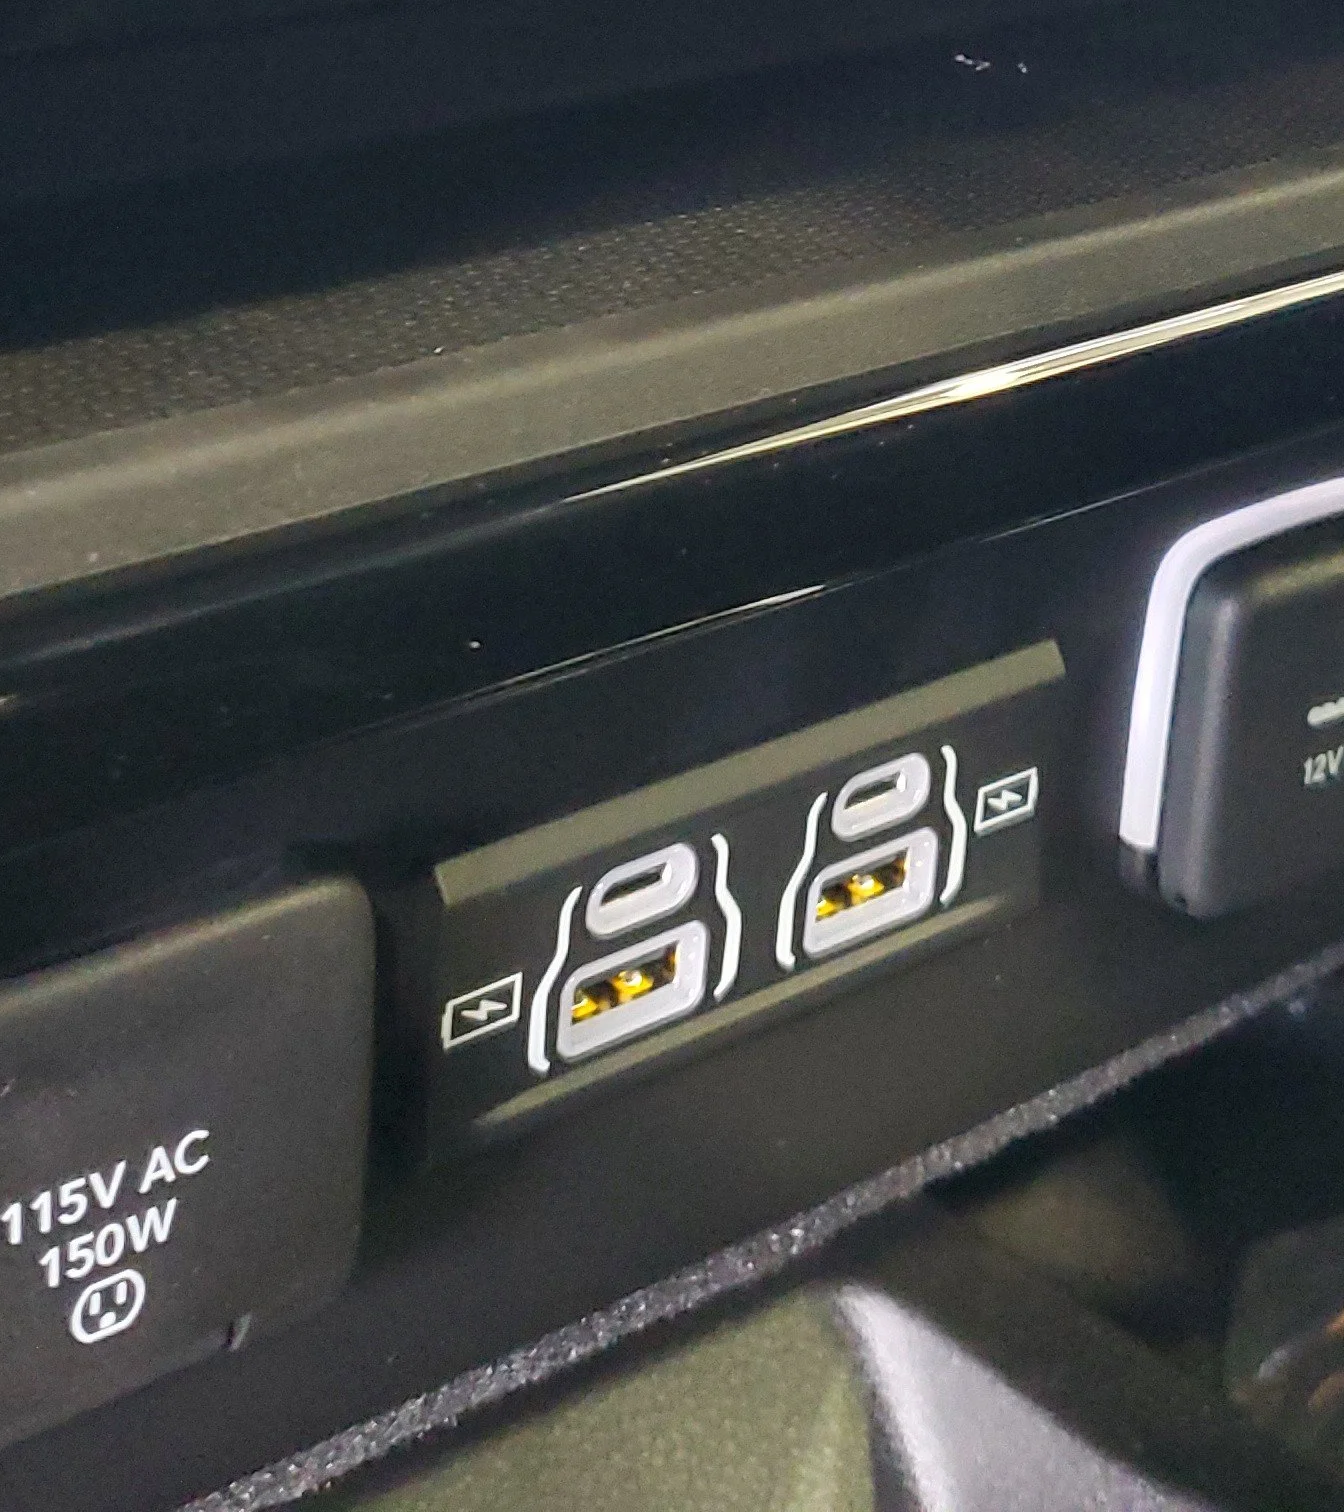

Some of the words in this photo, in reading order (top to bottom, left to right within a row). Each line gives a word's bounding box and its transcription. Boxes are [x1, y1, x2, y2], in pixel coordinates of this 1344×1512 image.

[1304, 745, 1344, 784] 12V
[0, 1160, 126, 1245] 115V
[139, 1129, 210, 1194] AC
[39, 1197, 177, 1288] 150W
